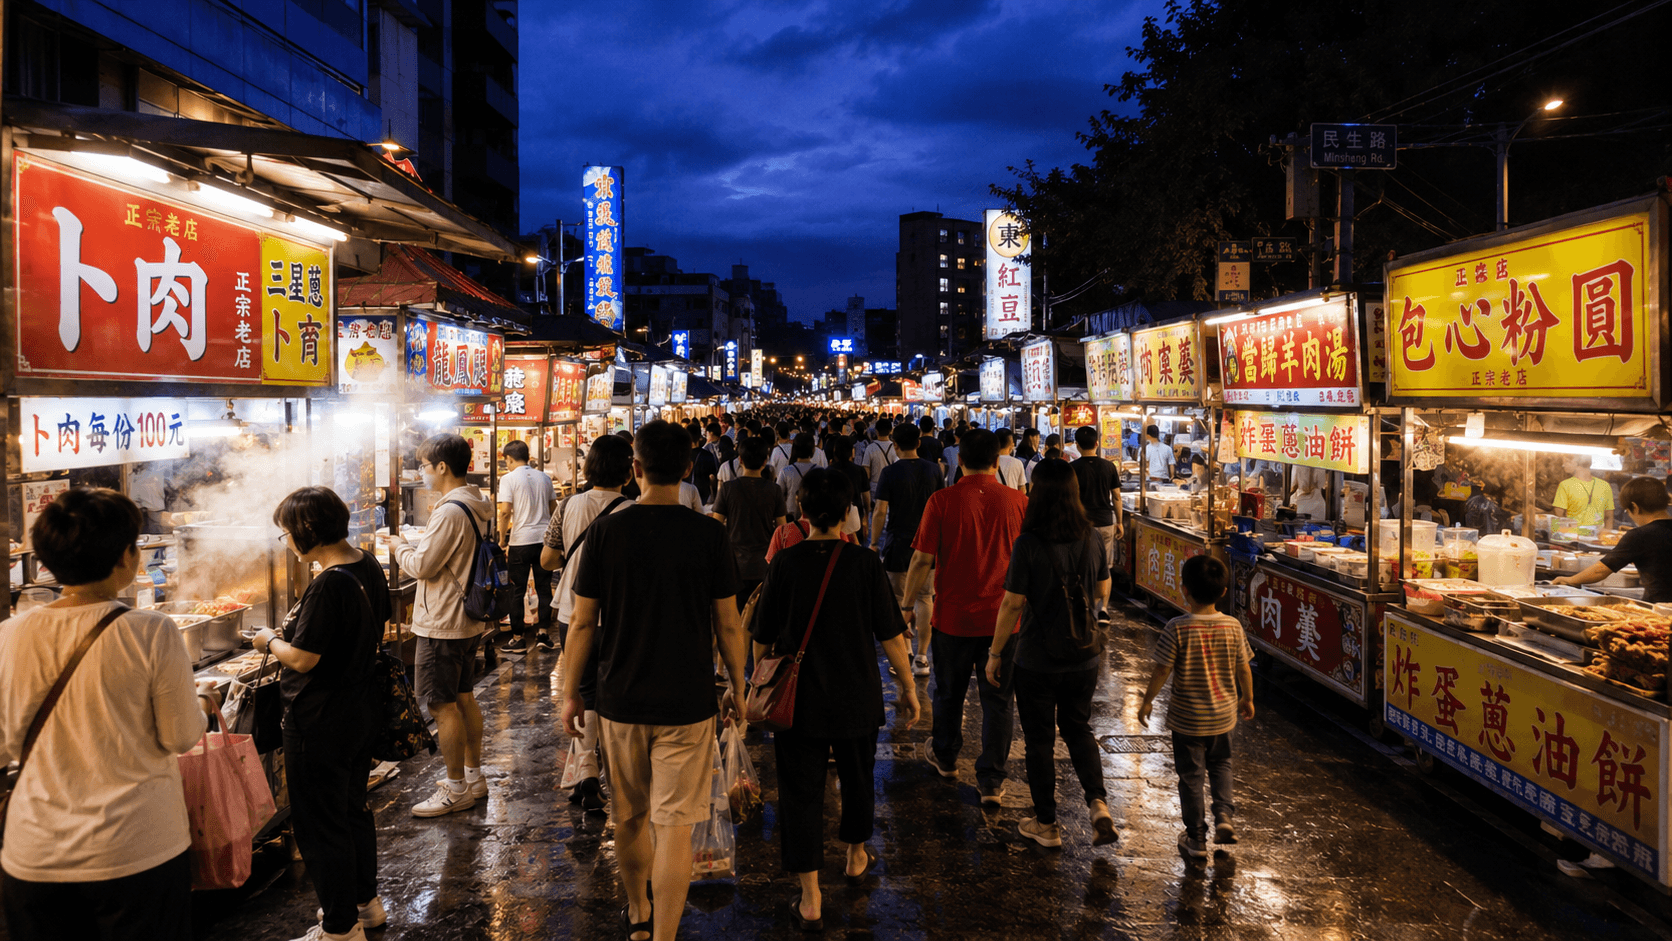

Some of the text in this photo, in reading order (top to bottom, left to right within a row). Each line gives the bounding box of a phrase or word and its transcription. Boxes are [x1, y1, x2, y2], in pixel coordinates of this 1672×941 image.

[1323, 130, 1386, 149] 民生路
[1324, 152, 1367, 166] Minsheng
[998, 223, 1021, 249] 東
[52, 206, 209, 362] 卜肉
[998, 263, 1022, 322] 紅豆
[234, 272, 252, 369] 正宗老店
[1398, 259, 1635, 372] 包心粉圓
[1471, 368, 1528, 387] 正宗老店
[33, 412, 185, 457] 卜肉每份100元
[1391, 644, 1653, 831] 炸蛋蔥油餅
